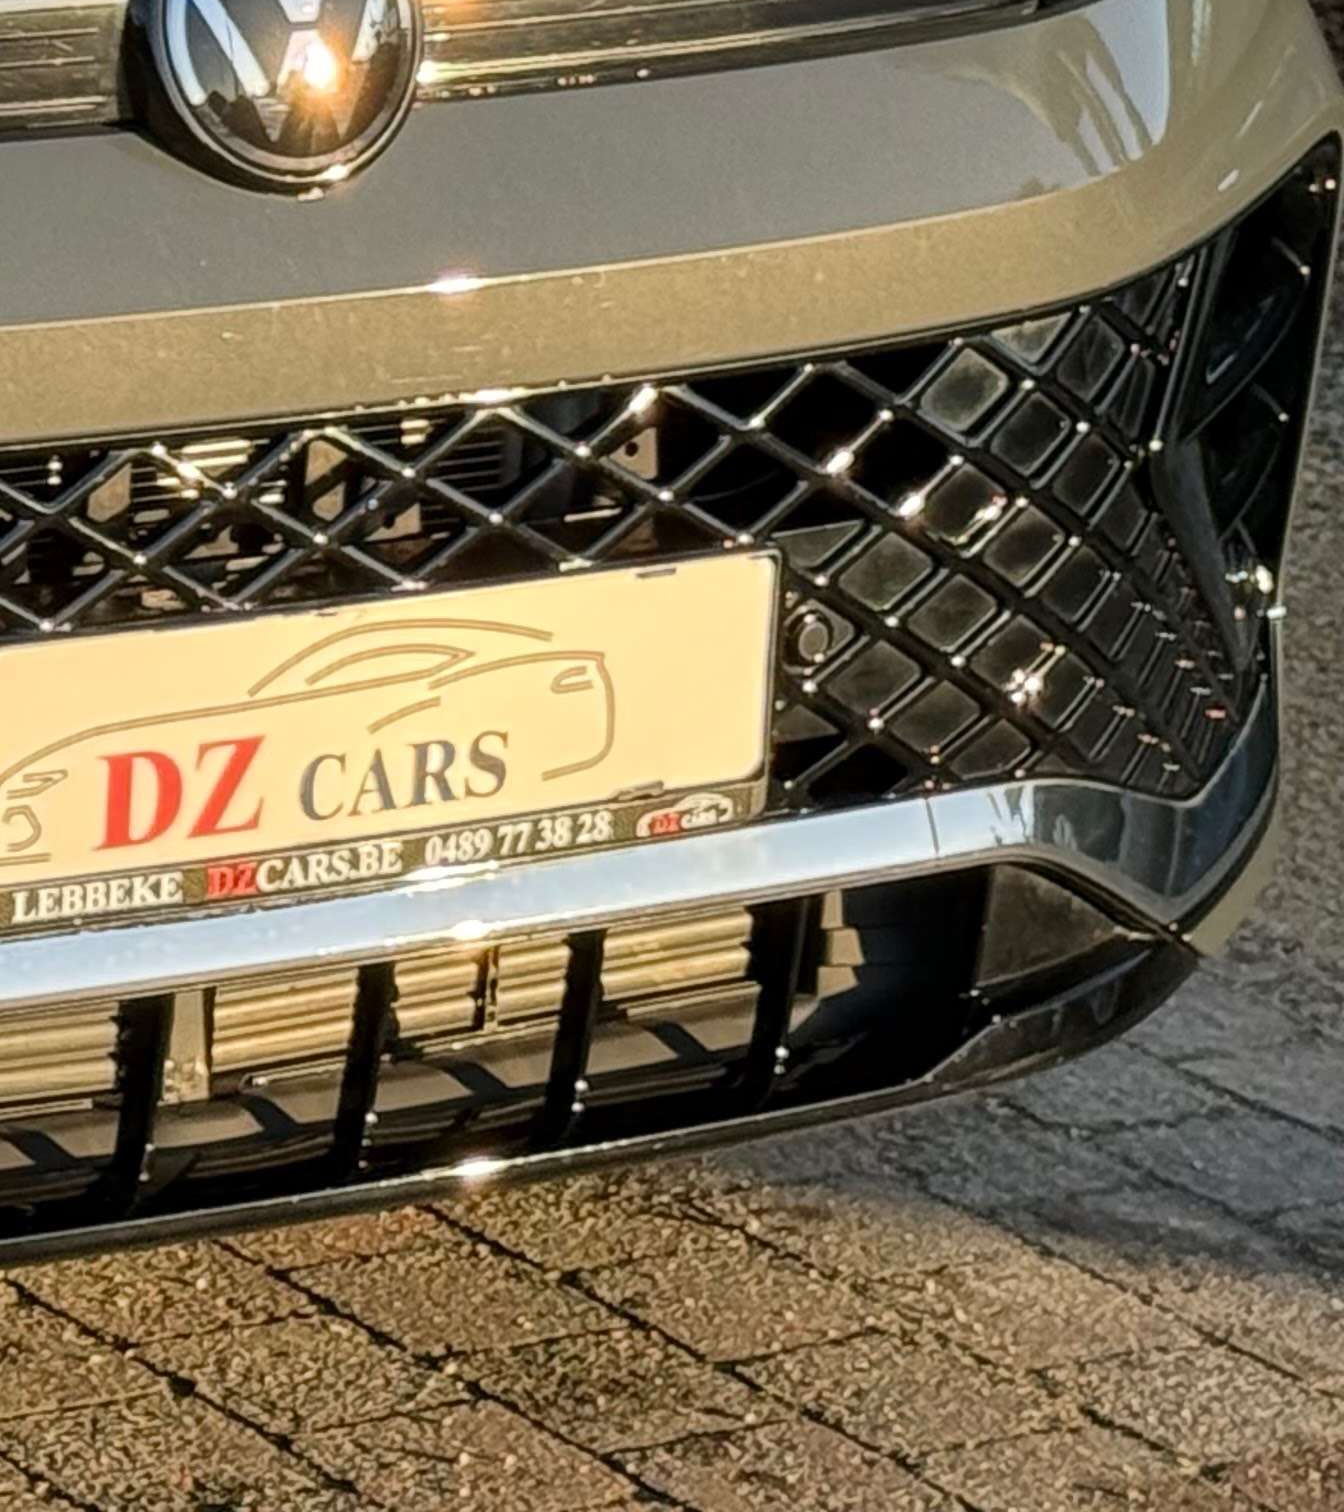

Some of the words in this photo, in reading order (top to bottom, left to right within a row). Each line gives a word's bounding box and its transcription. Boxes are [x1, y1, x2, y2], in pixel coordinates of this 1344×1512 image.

[94, 735, 265, 850] DZ
[298, 730, 510, 822] CARS
[11, 870, 185, 925] LEBBEKE
[206, 840, 405, 900] DZCARS.BE
[424, 826, 492, 866] 0489
[496, 822, 531, 856] 77
[535, 816, 575, 852] 38
[575, 810, 614, 845] 28
